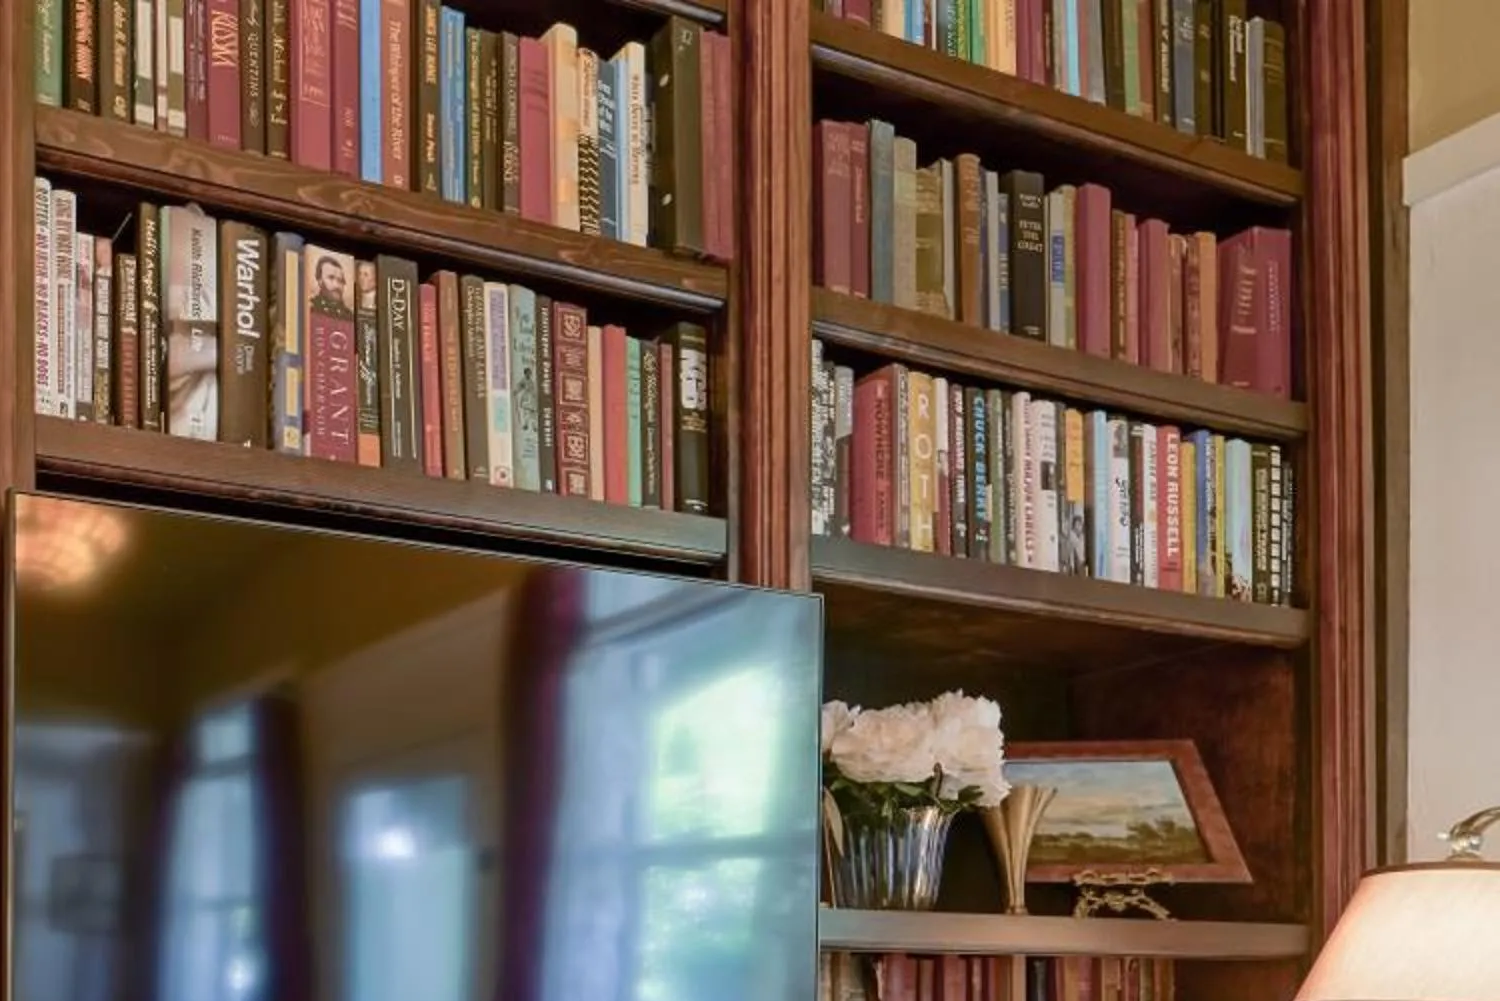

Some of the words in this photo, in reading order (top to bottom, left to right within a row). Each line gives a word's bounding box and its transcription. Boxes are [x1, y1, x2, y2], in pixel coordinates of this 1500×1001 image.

[191, 228, 203, 262] Keith
[191, 263, 204, 320] Richards
[236, 239, 260, 338] Warhol
[390, 278, 406, 332] D-DAY
[328, 330, 350, 446] GRANT
[874, 398, 885, 480] NOWHERE
[974, 396, 987, 453] CHUCK
[1166, 432, 1180, 477] LEON
[1166, 480, 1180, 558] RUSSELL
